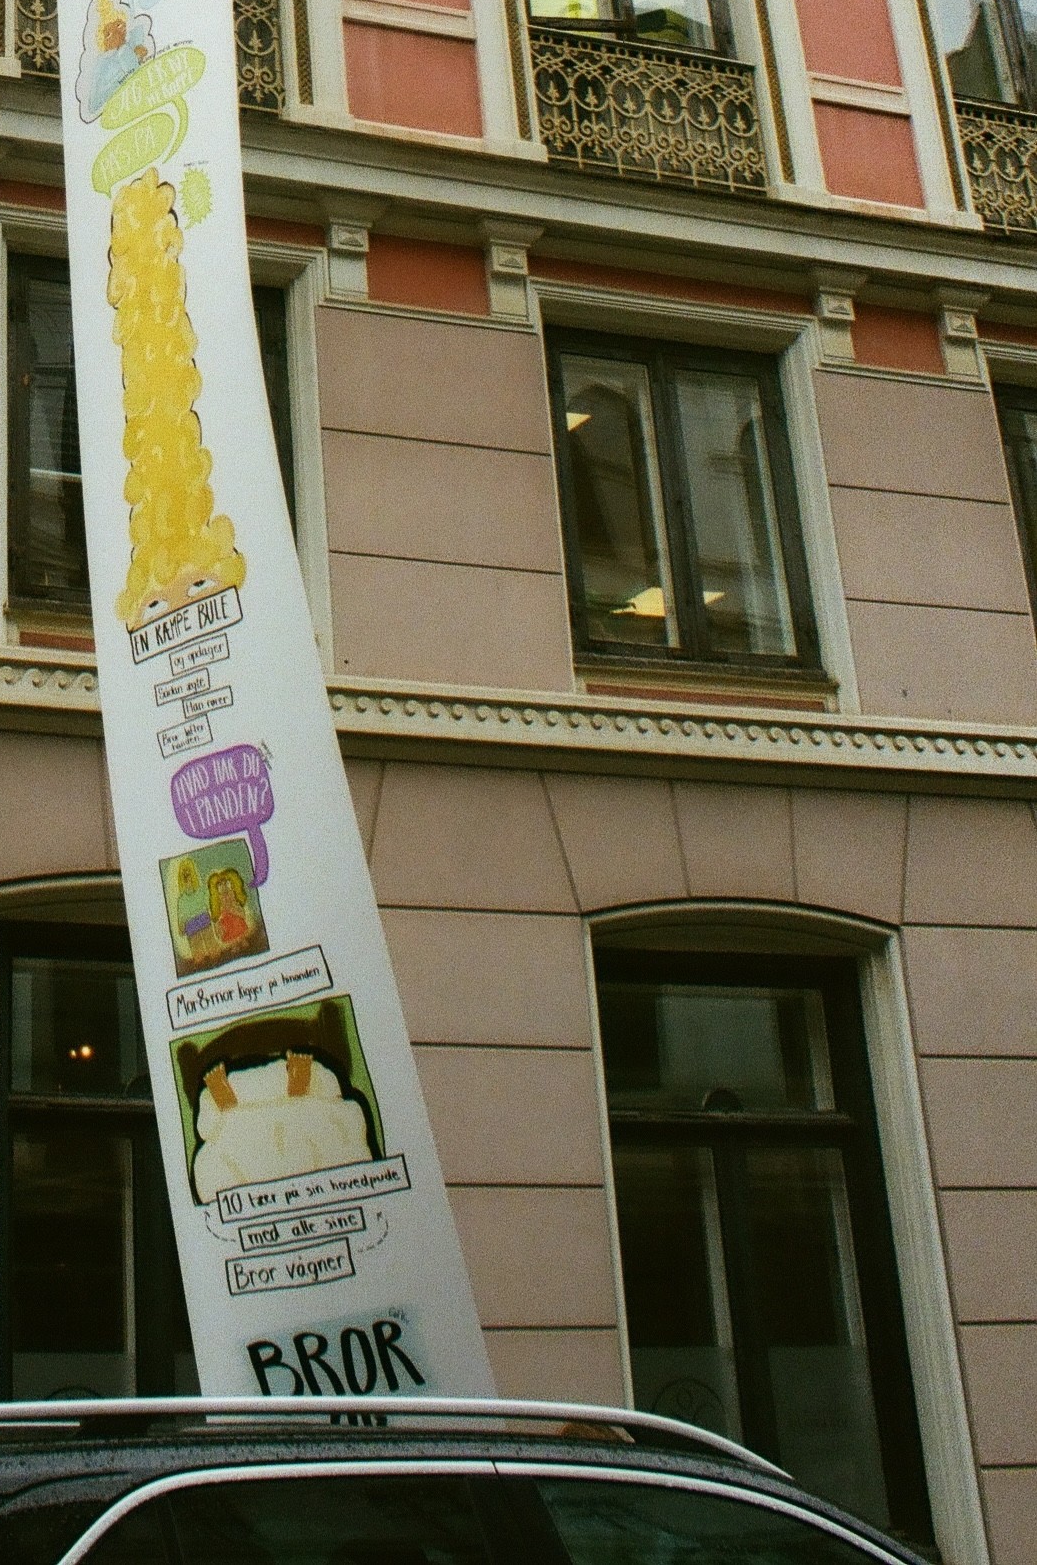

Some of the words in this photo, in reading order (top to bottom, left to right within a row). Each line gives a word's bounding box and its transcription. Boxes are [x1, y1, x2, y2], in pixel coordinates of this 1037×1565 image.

[134, 630, 150, 656] EN
[155, 609, 192, 647] KÆMPE
[197, 594, 228, 630] BULE
[188, 643, 224, 665] opdager
[185, 700, 204, 714] Han
[175, 763, 210, 805] HVAD
[212, 756, 238, 786] HAR
[242, 751, 260, 778] DU
[184, 807, 197, 833] I
[195, 776, 269, 829] PANDEN?
[237, 981, 263, 1002] kigger
[221, 1192, 243, 1216] 10
[248, 1192, 277, 1208] tæer
[284, 1184, 301, 1205] på
[307, 1183, 325, 1198] sin
[329, 1168, 401, 1191] hovedpude
[246, 1221, 279, 1245] med
[291, 1218, 316, 1237] alle
[327, 1212, 359, 1231] sine
[233, 1262, 277, 1290] Bror
[285, 1254, 346, 1282] vågner
[246, 1319, 427, 1396] BROR
